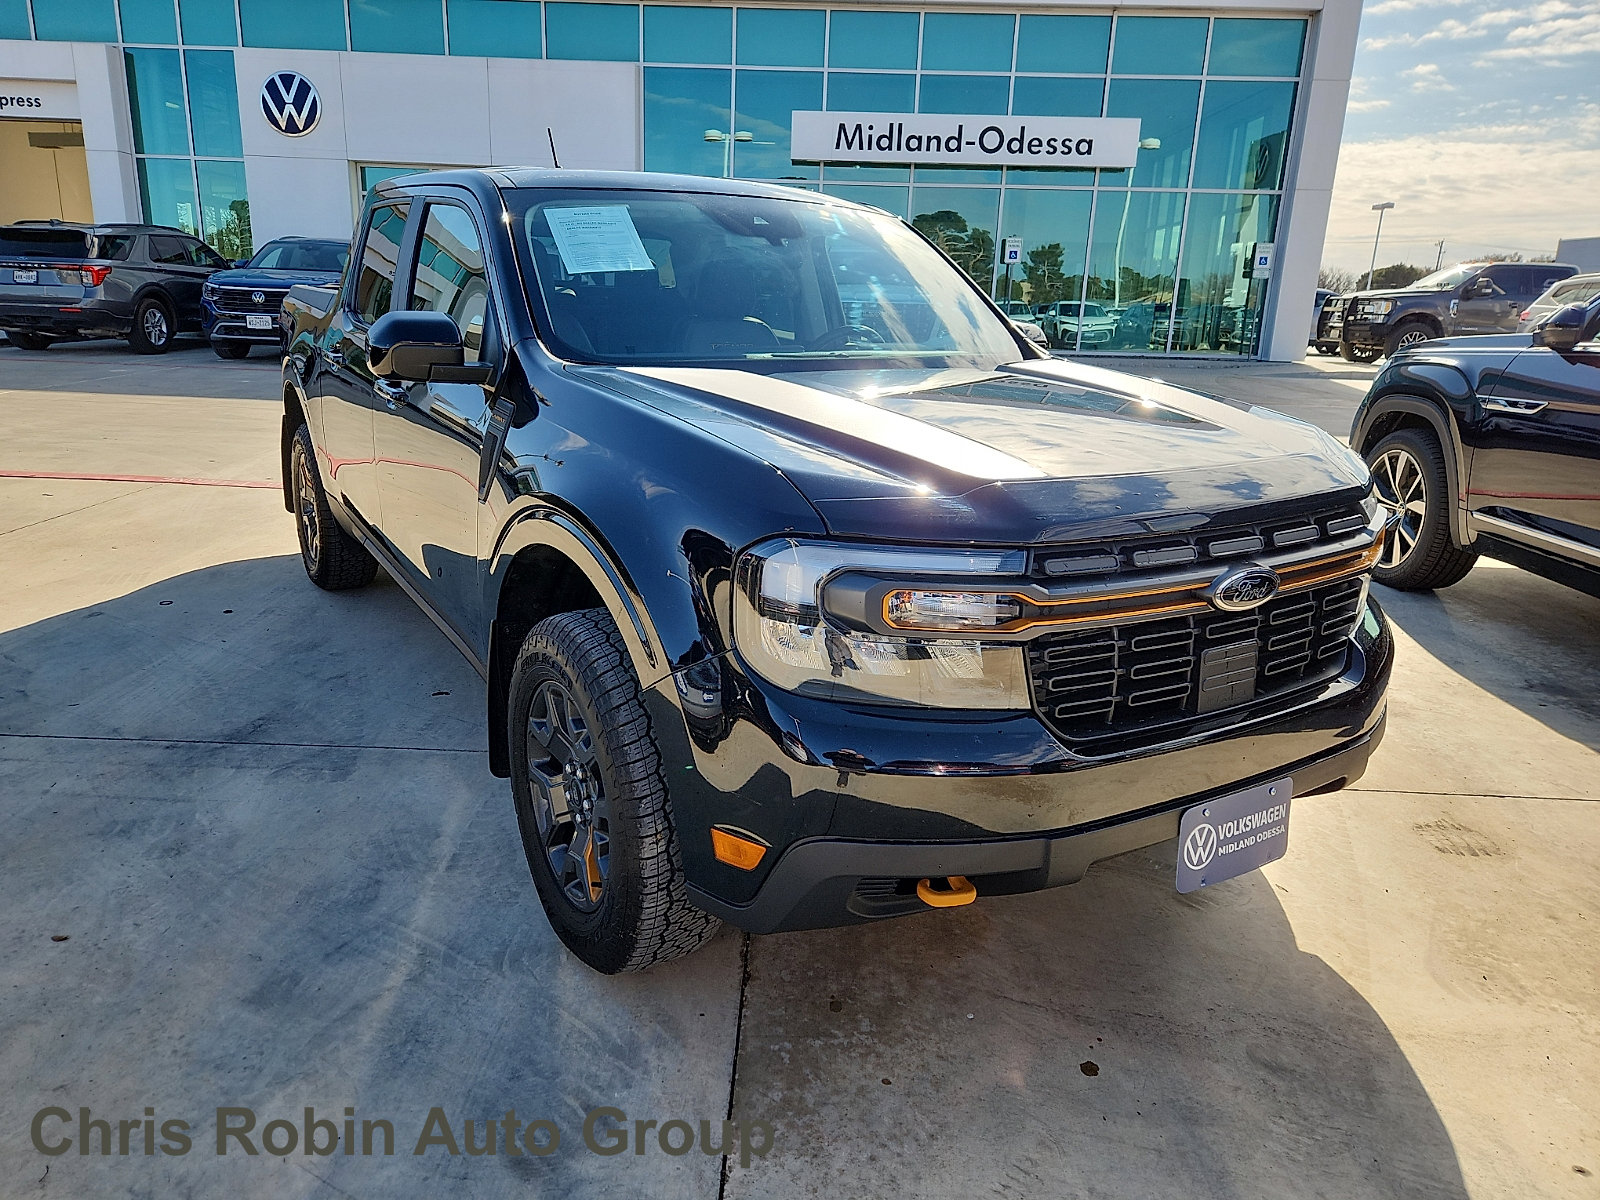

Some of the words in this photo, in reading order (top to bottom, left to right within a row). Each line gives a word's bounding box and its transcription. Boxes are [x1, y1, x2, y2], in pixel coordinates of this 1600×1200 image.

[834, 122, 1094, 157] Midland-Odessa
[1233, 578, 1270, 603] Ford
[1218, 803, 1287, 840] VOLKSWAGEN
[1218, 835, 1256, 857] MIDLAND
[1256, 824, 1286, 843] ODESSA
